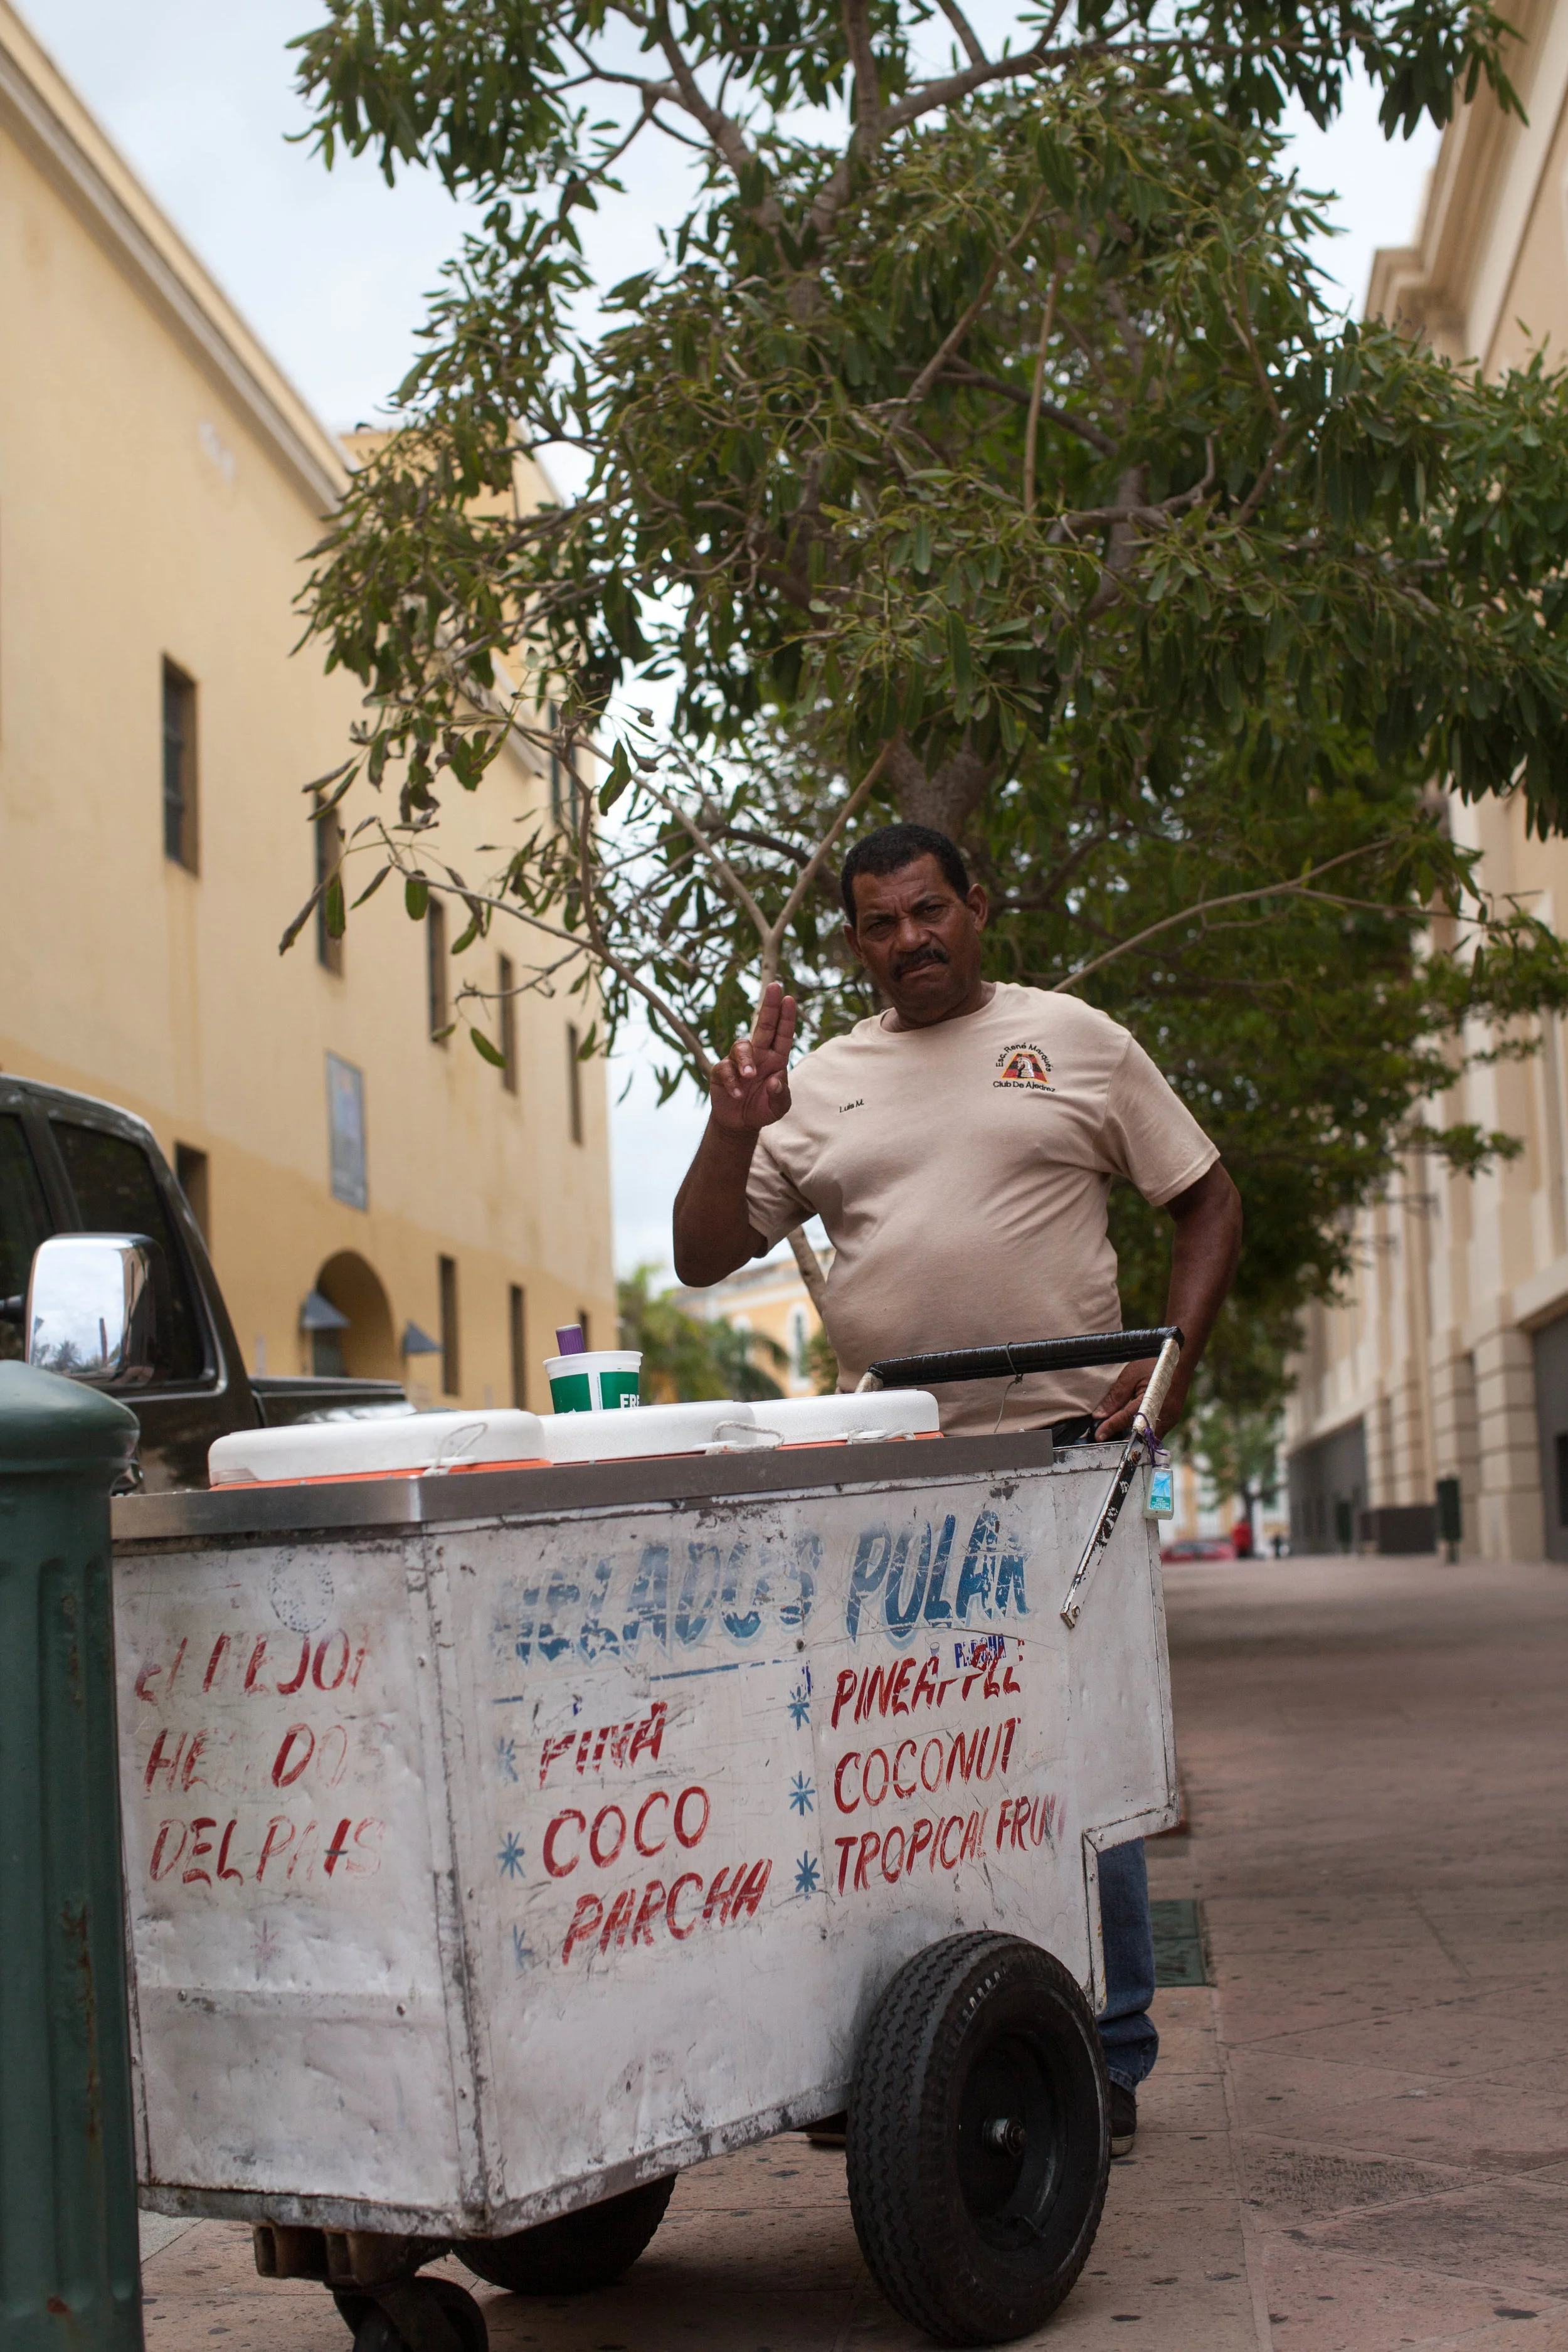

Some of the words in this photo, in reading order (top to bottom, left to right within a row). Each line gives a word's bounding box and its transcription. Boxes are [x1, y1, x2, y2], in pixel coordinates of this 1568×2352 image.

[995, 1052, 1007, 1067] Esc.
[1004, 1042, 1027, 1053] René
[1028, 1044, 1054, 1073] Marqués
[1025, 1081, 1056, 1093] Ajedrez
[839, 1103, 854, 1113] Luis
[834, 1717, 1022, 1814] COCONUT
[149, 1817, 244, 1887] DEL
[543, 1786, 711, 1878] COCO
[834, 1807, 989, 1897] TROPICAL
[561, 1858, 773, 1966] PARCHA
